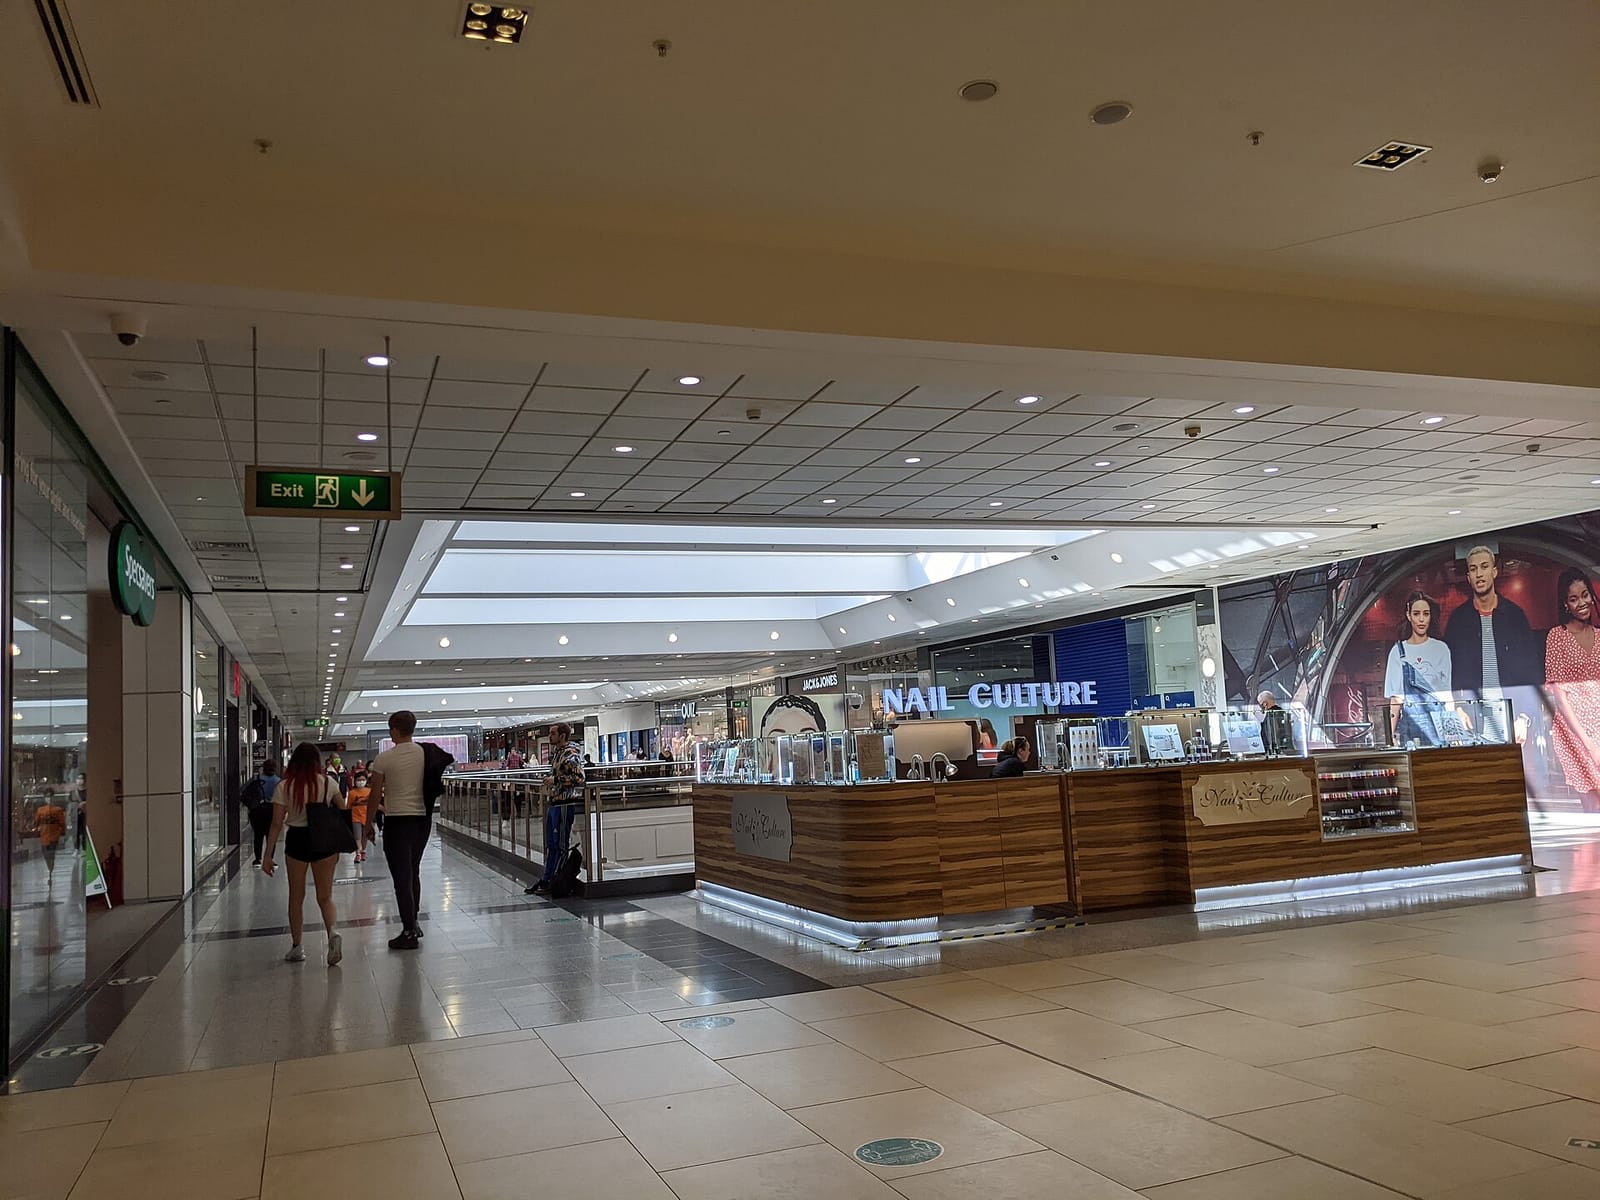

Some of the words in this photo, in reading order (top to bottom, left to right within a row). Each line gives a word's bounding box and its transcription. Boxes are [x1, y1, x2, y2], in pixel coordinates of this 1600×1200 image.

[270, 483, 304, 498] Exit
[124, 544, 155, 601] Specsavers
[882, 686, 955, 714] NAIL
[968, 680, 1098, 709] CULTURE
[681, 701, 696, 720] QUIZ
[1200, 787, 1239, 808] Nail
